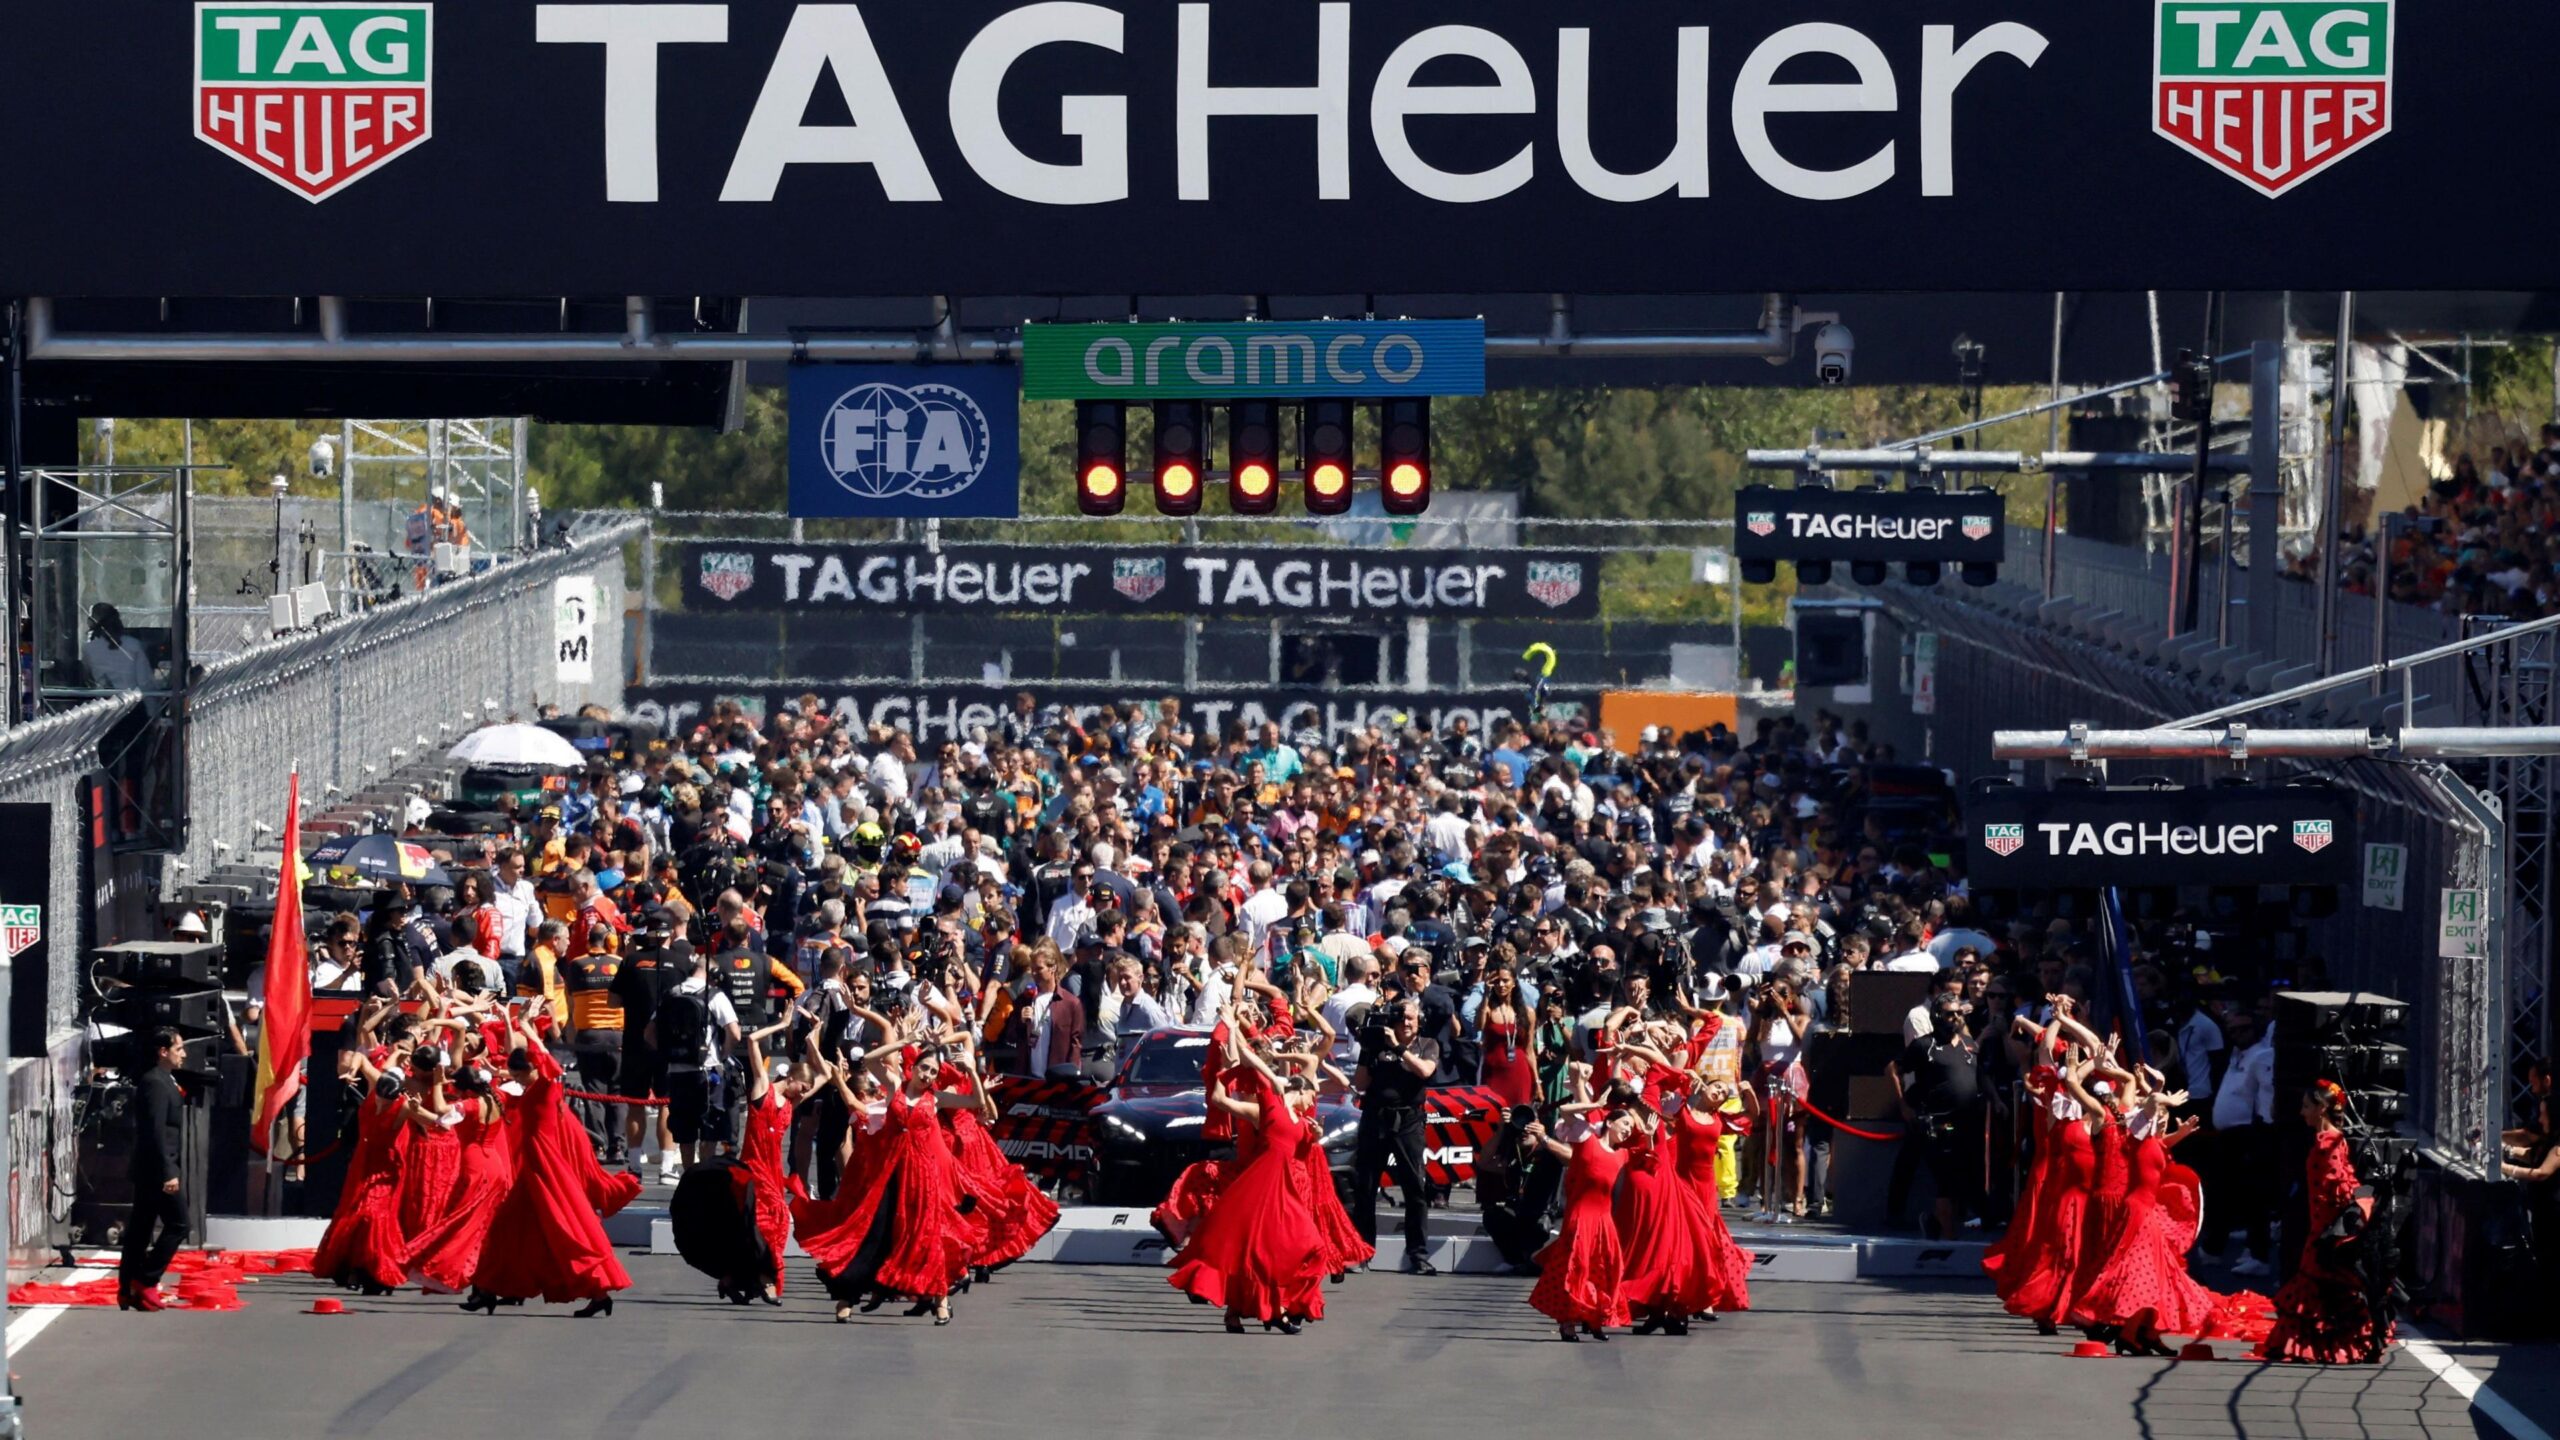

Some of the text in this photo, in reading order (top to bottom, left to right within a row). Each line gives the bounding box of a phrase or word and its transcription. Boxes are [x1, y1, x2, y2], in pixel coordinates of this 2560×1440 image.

[216, 16, 409, 75] TAG
[2175, 9, 2370, 68] TAG
[209, 95, 417, 187] HEUER
[2168, 89, 2376, 181] HEUER
[1084, 334, 1424, 385] aramco
[1988, 826, 2020, 836] TAG
[2297, 822, 2329, 833] TAG
[1987, 838, 2021, 854] HEUER
[2295, 835, 2330, 851] HEUER
[2367, 878, 2397, 889] EXIT
[0, 908, 35, 924] AG
[2445, 925, 2477, 937] EXIT
[1422, 1146, 1473, 1165] MG
